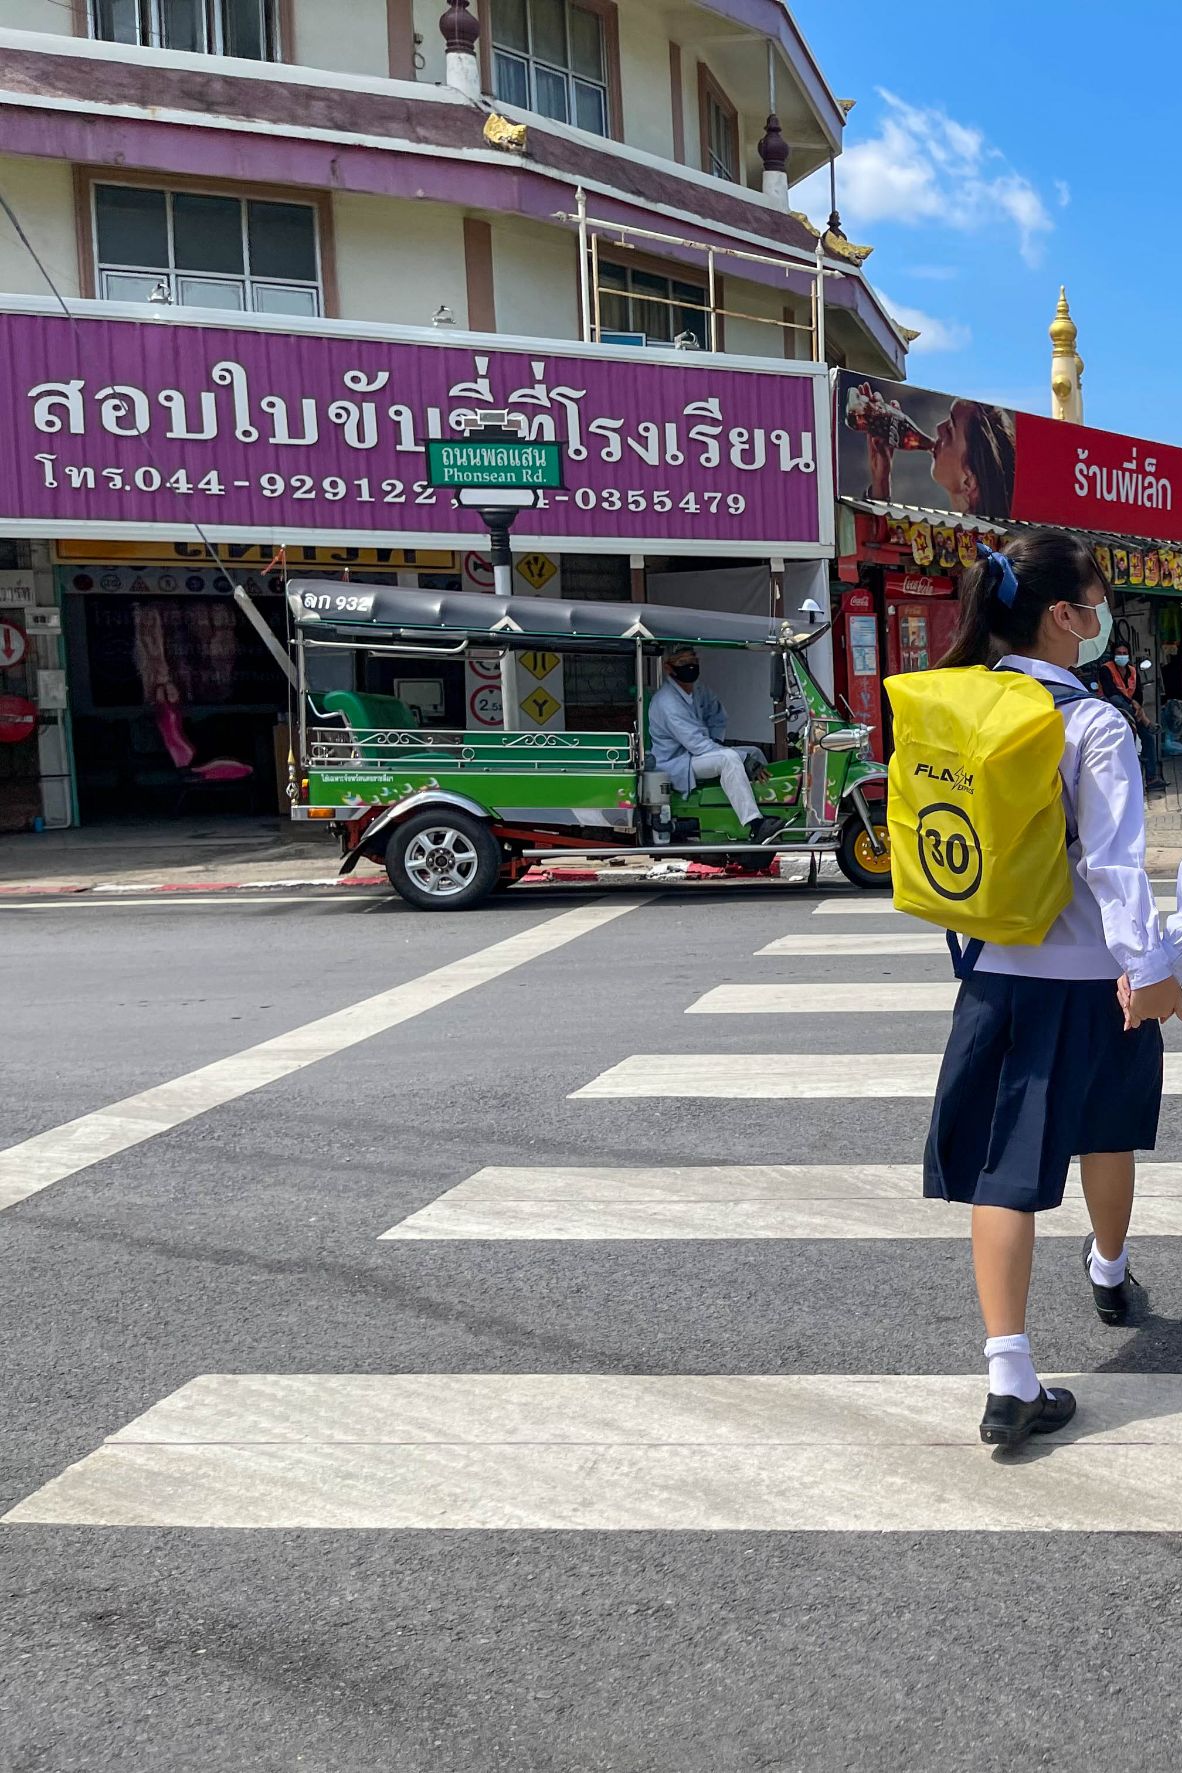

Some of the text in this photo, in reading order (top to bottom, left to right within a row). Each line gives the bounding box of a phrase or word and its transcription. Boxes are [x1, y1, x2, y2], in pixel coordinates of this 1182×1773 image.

[441, 447, 547, 467] ถนนพลแสน
[444, 468, 547, 483] Phonsean Rd.
[1074, 447, 1172, 510] ร้านพี่เล็ก
[925, 828, 970, 875] 30
